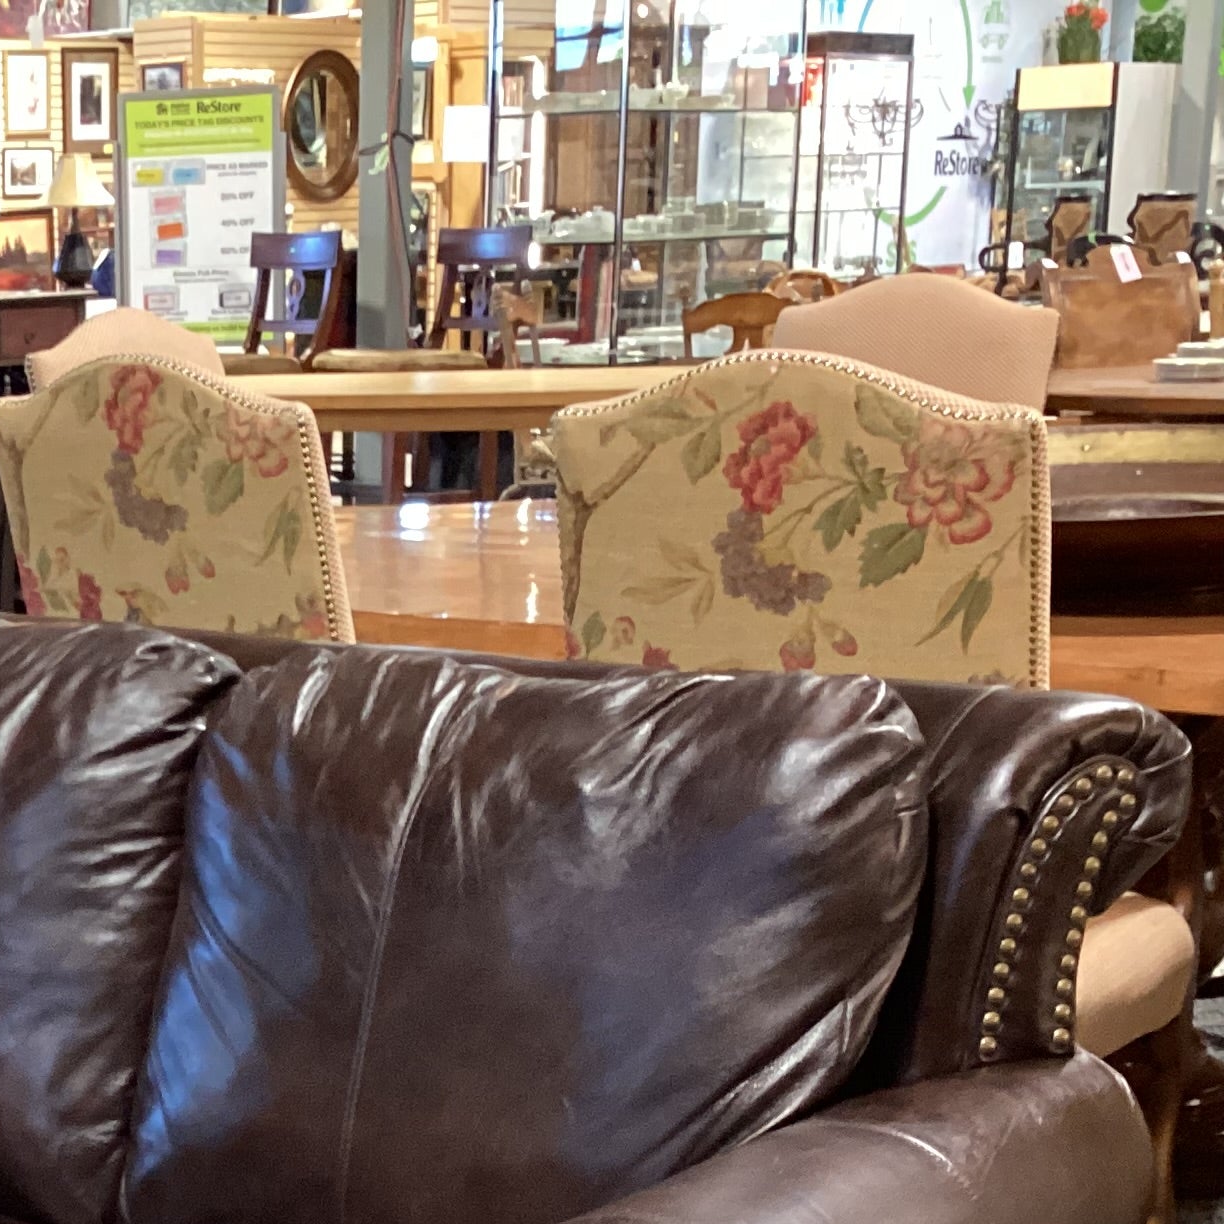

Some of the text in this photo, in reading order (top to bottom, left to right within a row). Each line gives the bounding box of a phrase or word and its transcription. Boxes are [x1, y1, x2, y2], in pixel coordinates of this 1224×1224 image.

[196, 100, 242, 114] ReStore
[171, 118, 195, 128] PRICE
[934, 149, 979, 176] ReStore
